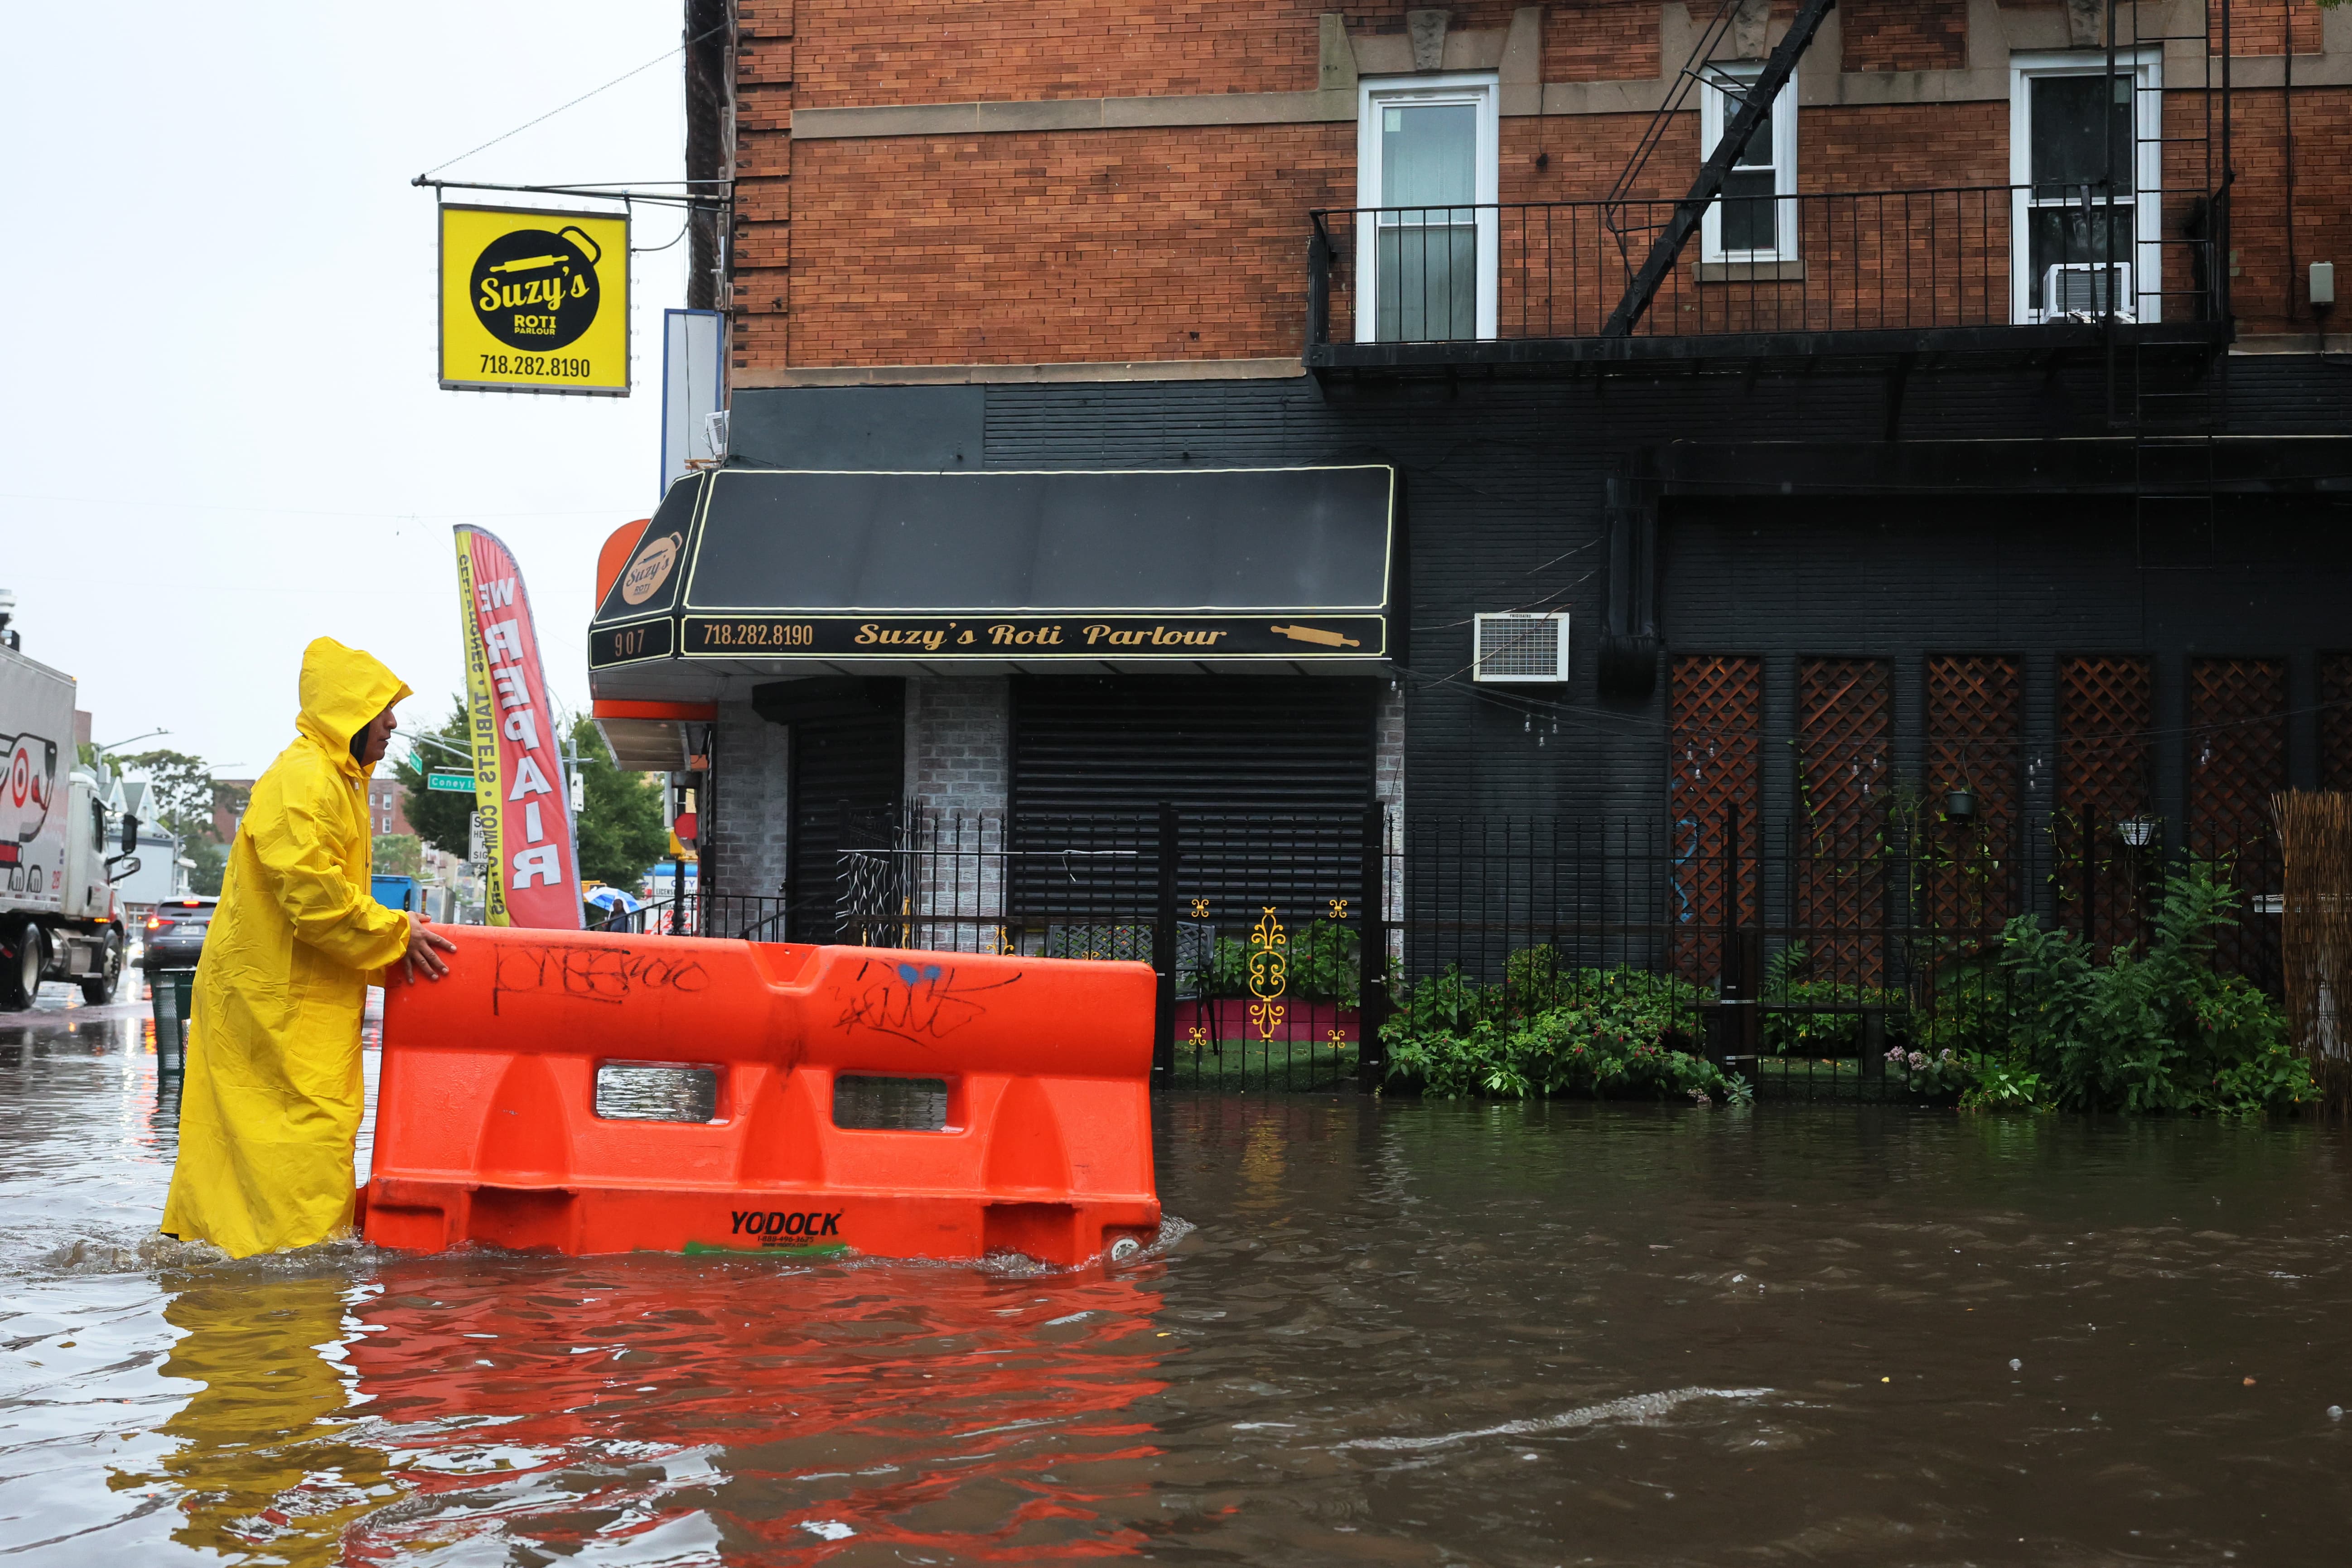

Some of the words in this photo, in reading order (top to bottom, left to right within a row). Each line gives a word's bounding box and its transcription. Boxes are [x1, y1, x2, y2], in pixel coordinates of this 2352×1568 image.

[479, 266, 590, 312] Suzy's
[514, 314, 556, 328] ROTI
[480, 355, 590, 377] 718.282.8190
[626, 555, 669, 587] Suzy's
[615, 629, 644, 657] 907
[704, 624, 813, 645] 718.282.8190
[855, 622, 978, 650] Suzy's
[988, 624, 1064, 646] Roti
[1082, 624, 1227, 646] Parlour
[432, 777, 465, 790] Coney
[732, 1211, 842, 1235] YODOCK
